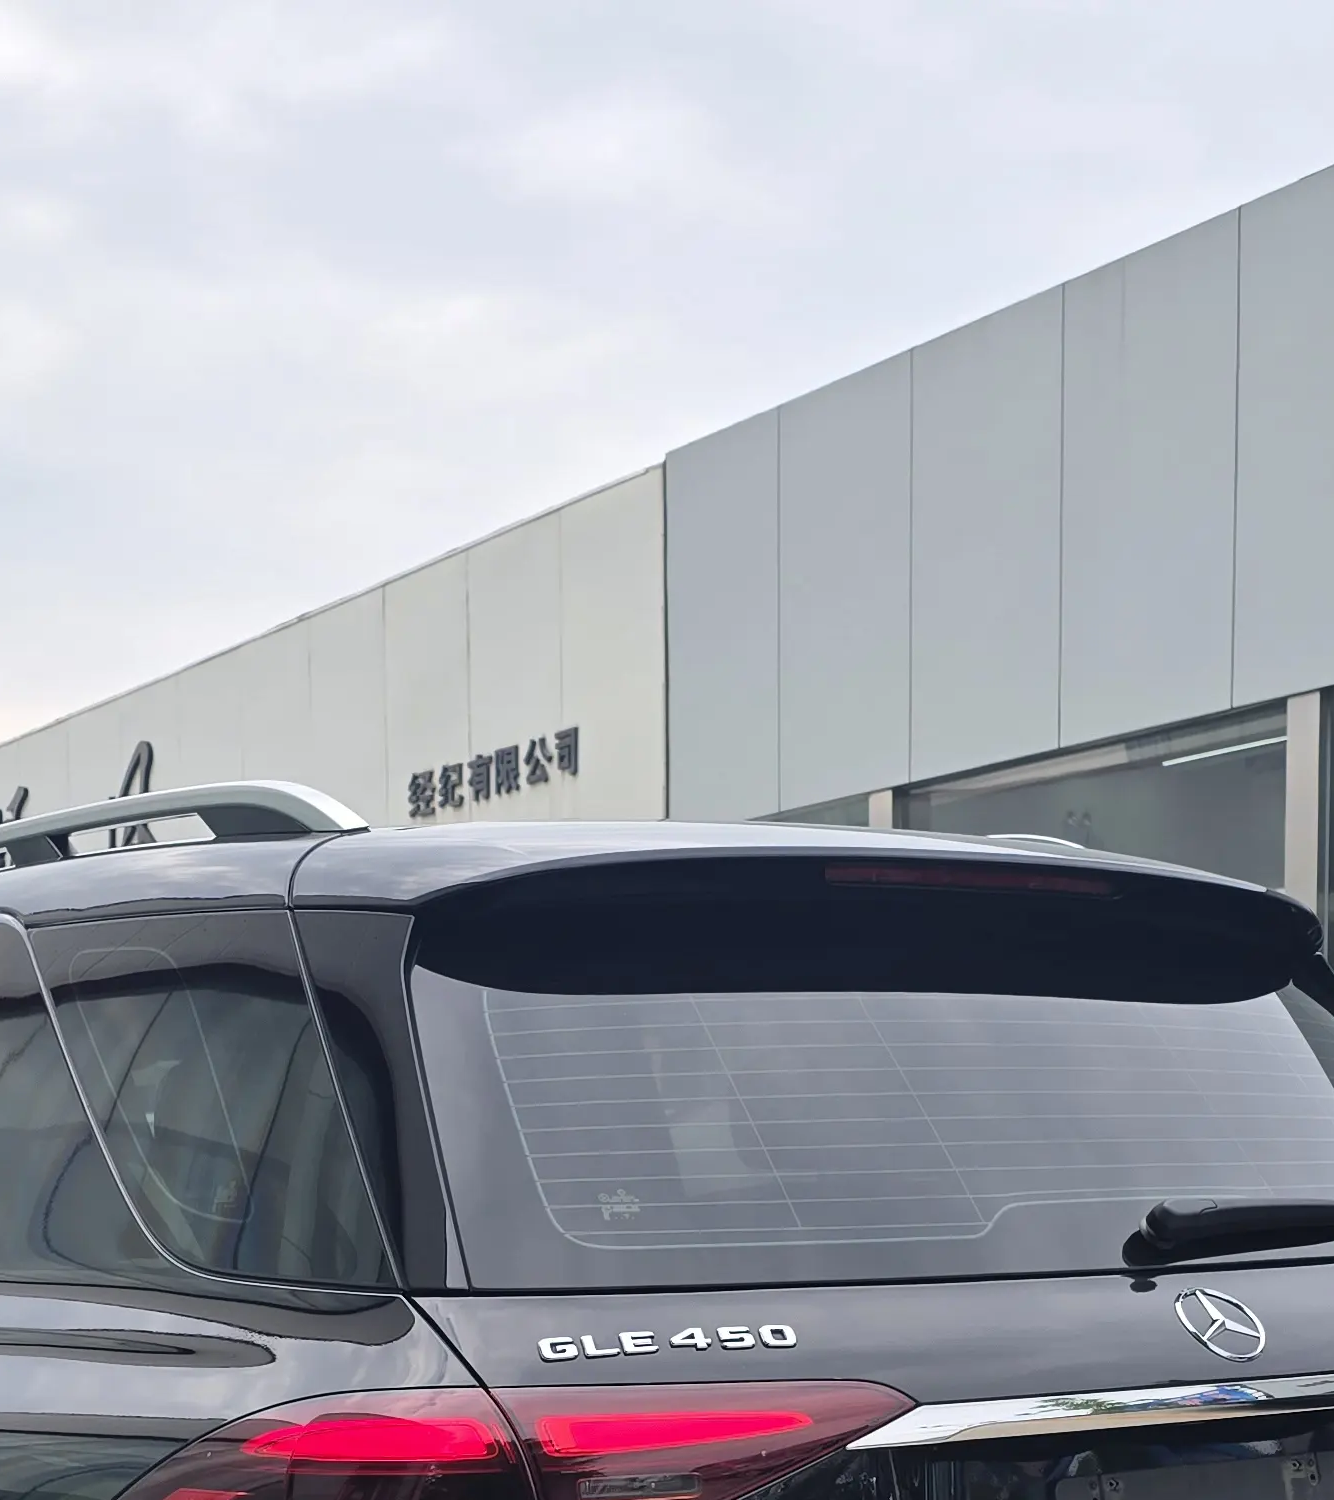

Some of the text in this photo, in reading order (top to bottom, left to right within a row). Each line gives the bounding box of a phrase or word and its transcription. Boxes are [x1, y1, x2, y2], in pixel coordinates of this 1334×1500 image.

[408, 726, 580, 819] 经纪有限公司
[538, 1325, 798, 1362] GLE 450
